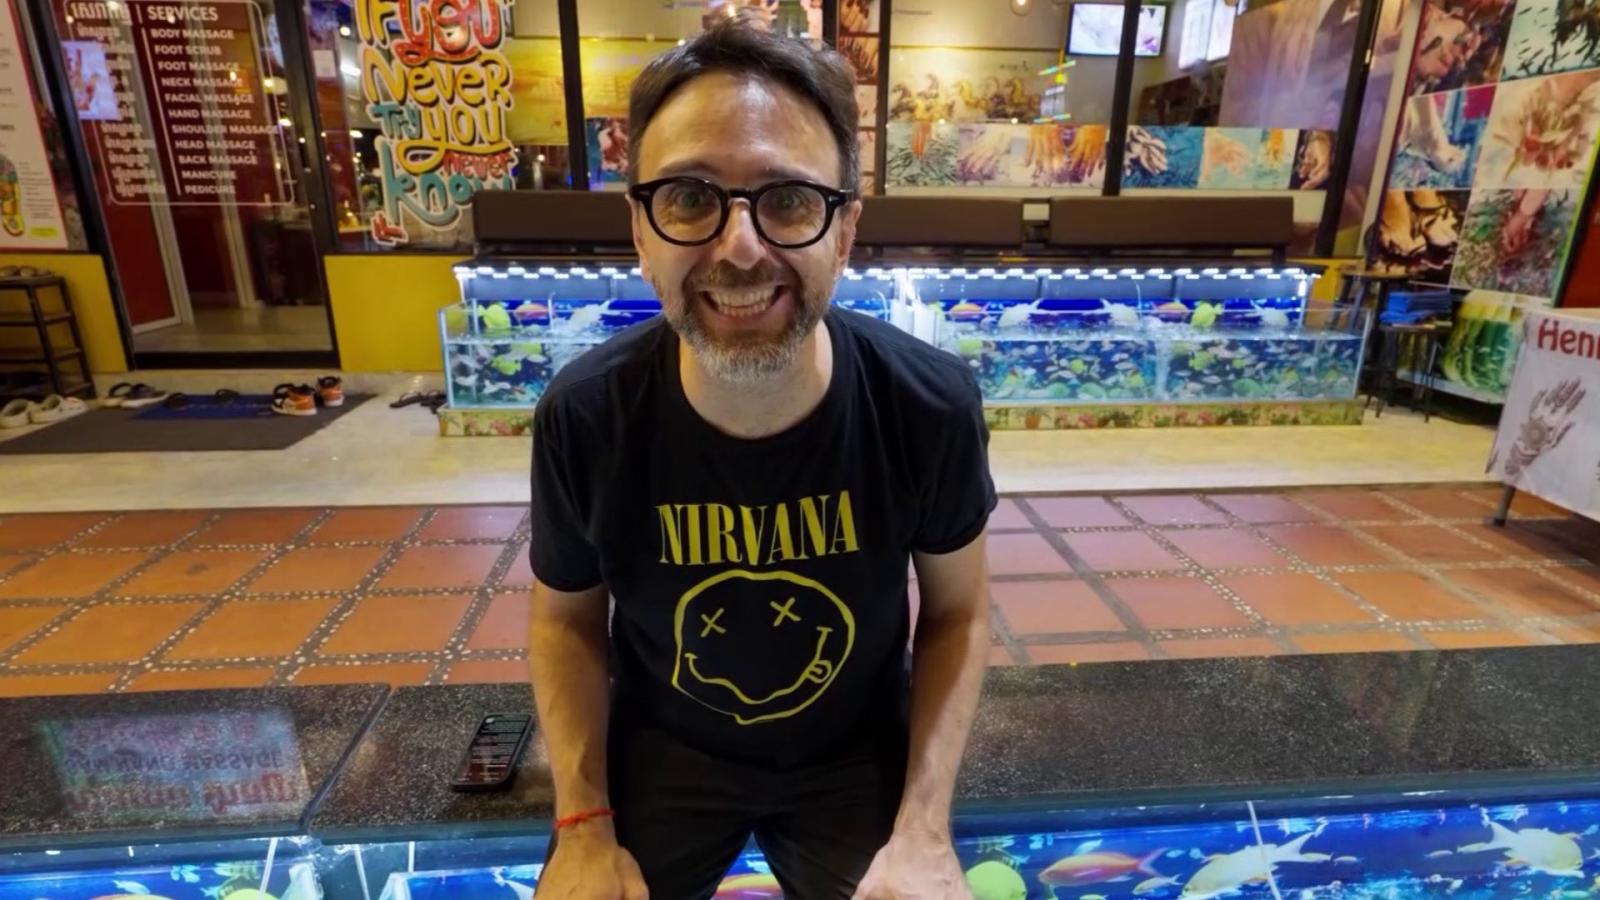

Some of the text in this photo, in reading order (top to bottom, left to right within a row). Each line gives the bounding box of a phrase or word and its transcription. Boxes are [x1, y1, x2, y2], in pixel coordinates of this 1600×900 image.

[147, 5, 219, 21] SERVICES
[150, 29, 235, 39] BODY MASSAGE
[154, 45, 222, 55] FOOT SCRUB
[158, 61, 239, 72] FOOT MASSAGE
[161, 77, 243, 87] NECK MASSAGE
[165, 93, 254, 103] FACIAL MASSAGE
[168, 109, 251, 119] HAND MASSAGE
[171, 124, 280, 134] SHOULDER MASSAGE
[175, 140, 256, 150] HEAD MASSAGE
[178, 155, 258, 165] BACK MASSAGE
[181, 170, 237, 179] MANICURE
[184, 185, 236, 195] PEDICURE
[1538, 318, 1600, 360] Hen
[655, 490, 860, 566] NIRVANA
